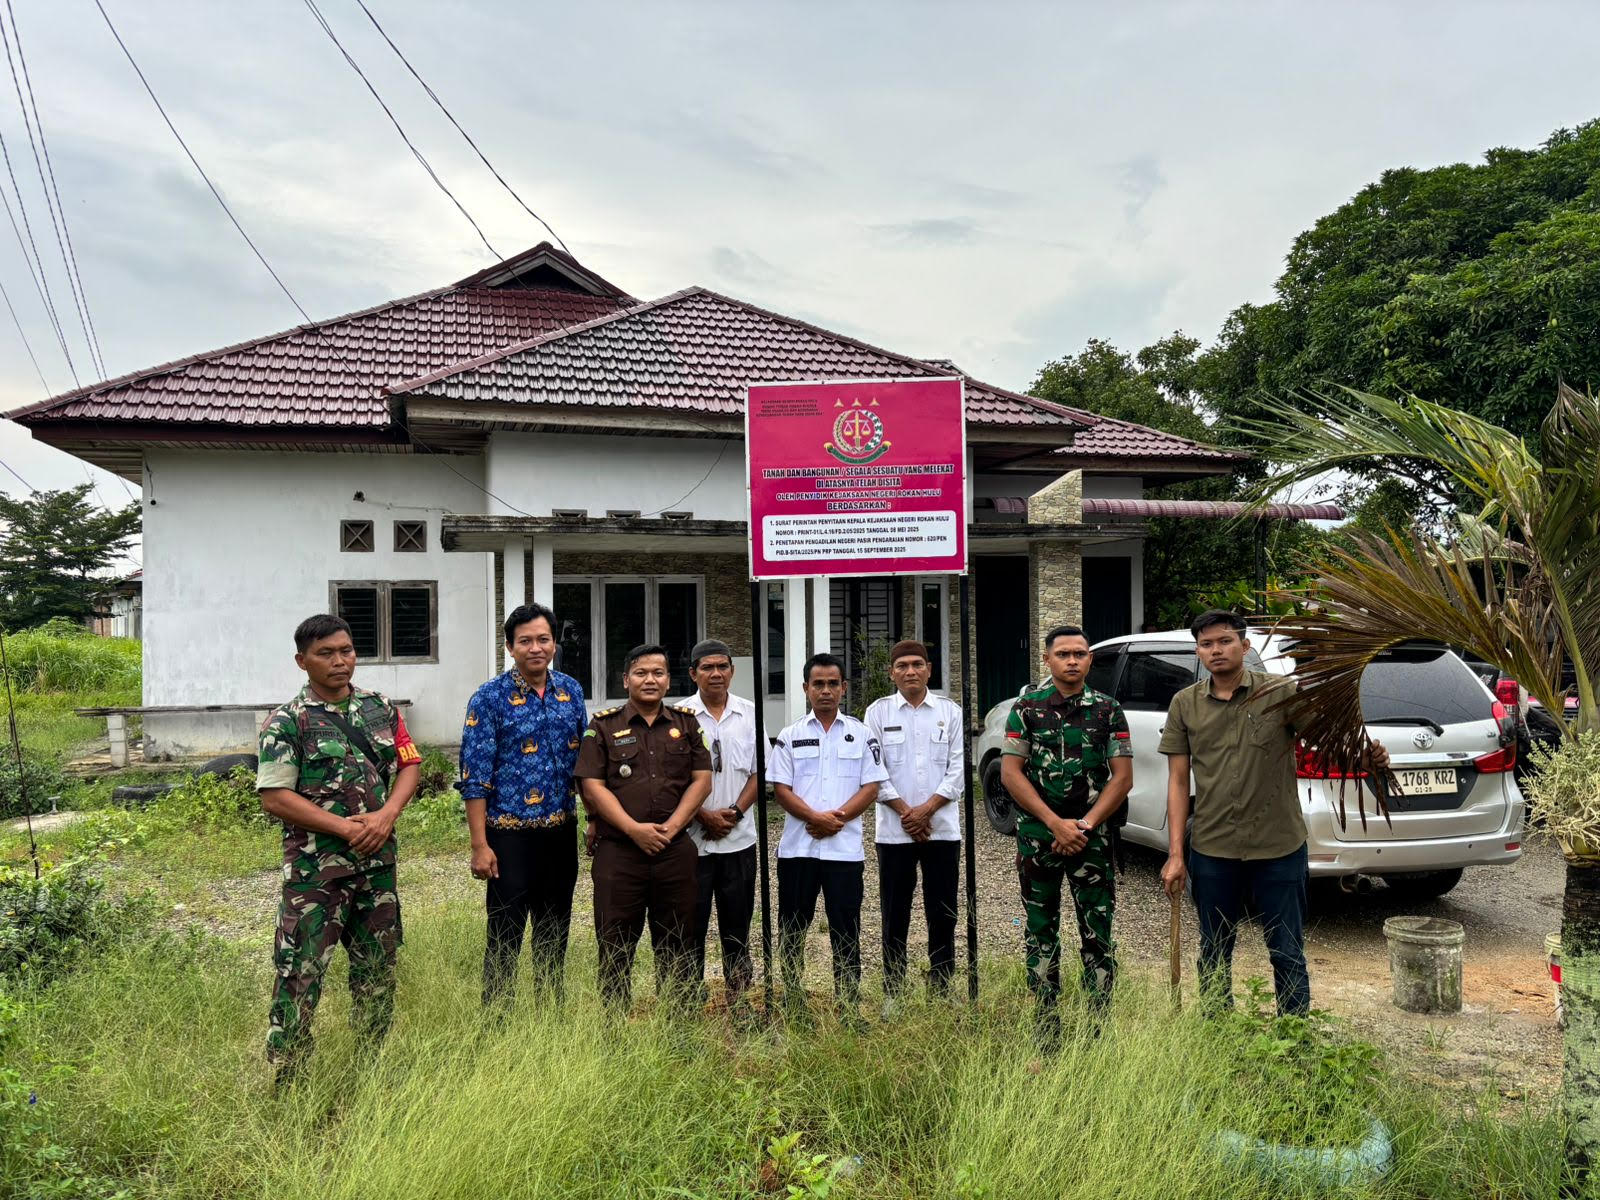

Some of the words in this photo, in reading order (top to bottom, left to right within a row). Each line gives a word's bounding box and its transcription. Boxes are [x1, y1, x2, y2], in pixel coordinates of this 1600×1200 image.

[762, 469, 785, 478] TANAH
[786, 468, 800, 478] DAN
[801, 468, 840, 477] BANGUNAN
[846, 467, 871, 476] SEGALA
[873, 466, 903, 476] SESUATU
[904, 465, 922, 475] YANG
[923, 464, 954, 474] MELEKAT
[816, 479, 824, 488] DI
[825, 478, 856, 488] ATASNYA
[857, 478, 876, 487] TELAH
[877, 477, 901, 487] DISITA
[796, 492, 828, 500] PENYIDIK
[829, 490, 869, 499] KEJAKSAAN
[897, 489, 920, 497] ROKAN
[922, 488, 941, 497] HULU
[827, 501, 886, 511] BERDASARKAN
[1402, 771, 1429, 786] 1768
[1434, 770, 1455, 785] KRZ
